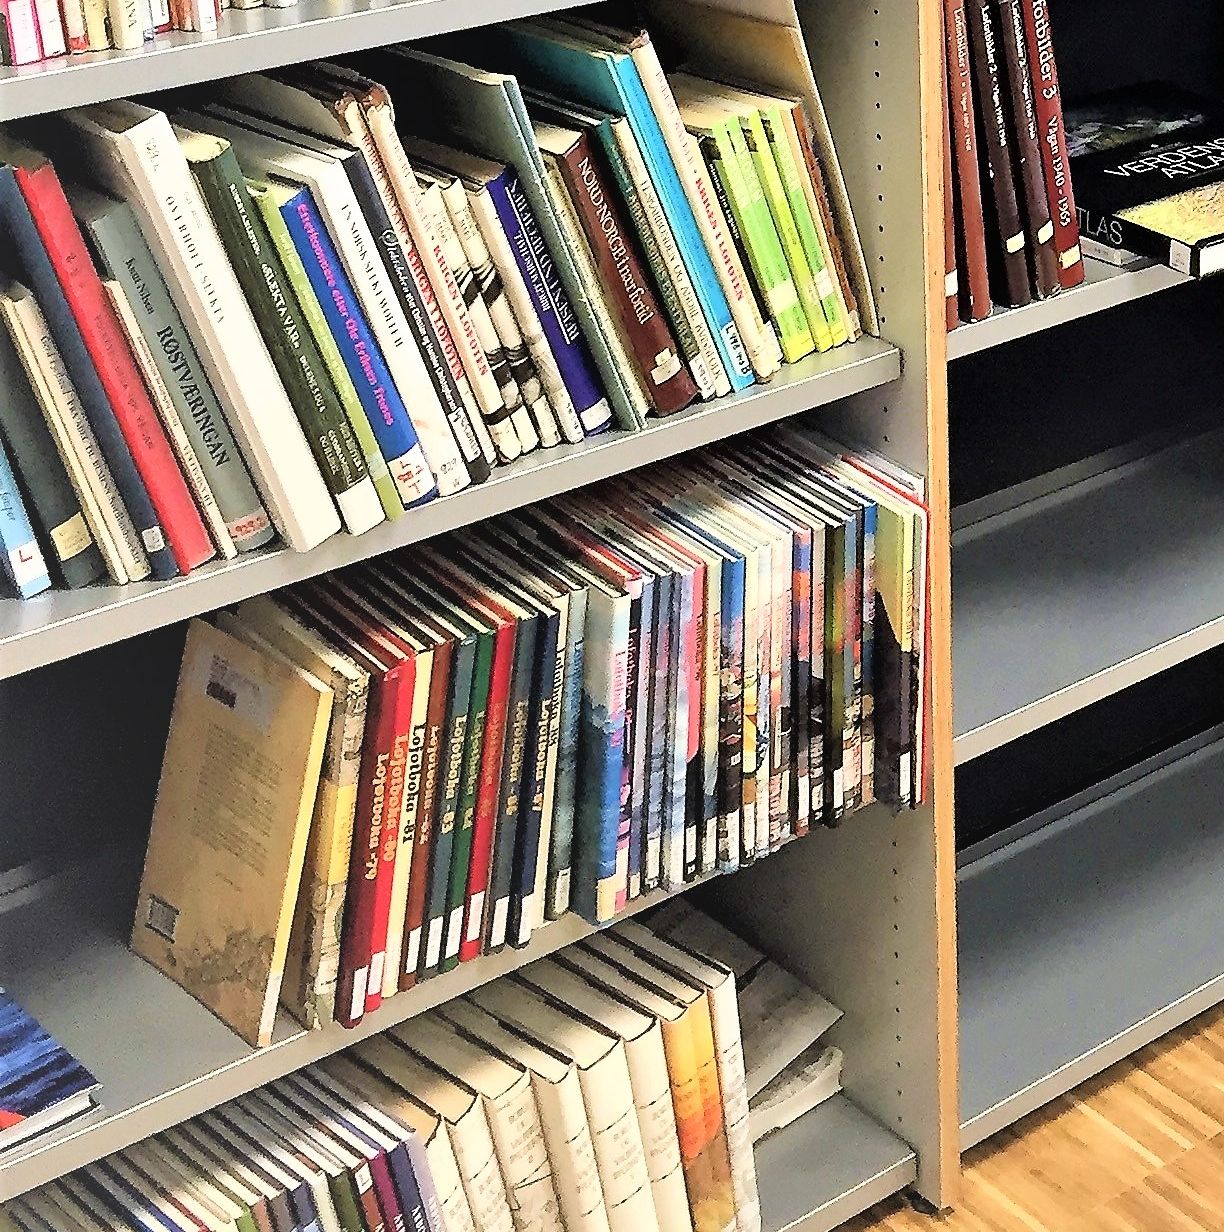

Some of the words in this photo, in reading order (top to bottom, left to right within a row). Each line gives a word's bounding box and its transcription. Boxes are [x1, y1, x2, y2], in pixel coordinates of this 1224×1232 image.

[953, 6, 970, 68] Lofotbilder
[981, 4, 998, 63] Lofotbilder
[1011, 0, 1028, 57] Lofotbilder
[1042, 83, 1057, 100] 3
[1051, 156, 1066, 186] 1940
[408, 249, 434, 306] KRIGEN
[435, 316, 466, 381] LOFOTEN
[432, 243, 460, 300] KRIGEN
[456, 313, 489, 377] LOFOTEN
[404, 722, 427, 813] Lofotboka
